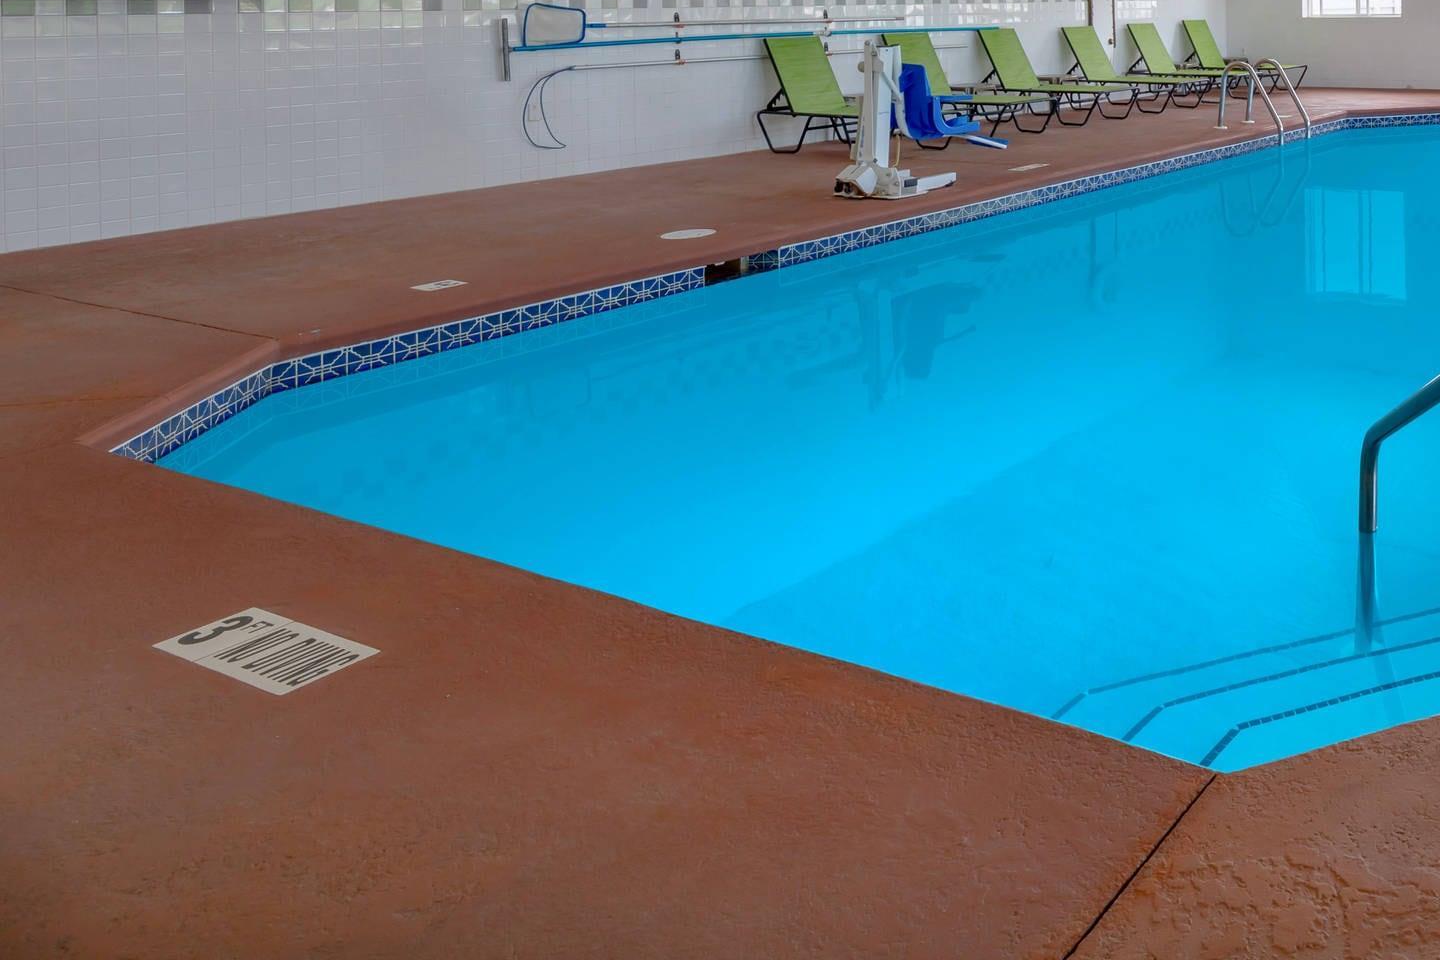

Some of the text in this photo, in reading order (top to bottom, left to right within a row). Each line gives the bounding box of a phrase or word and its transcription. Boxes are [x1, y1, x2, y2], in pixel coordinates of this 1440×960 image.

[177, 615, 360, 687] 3 FT NO DIVING
